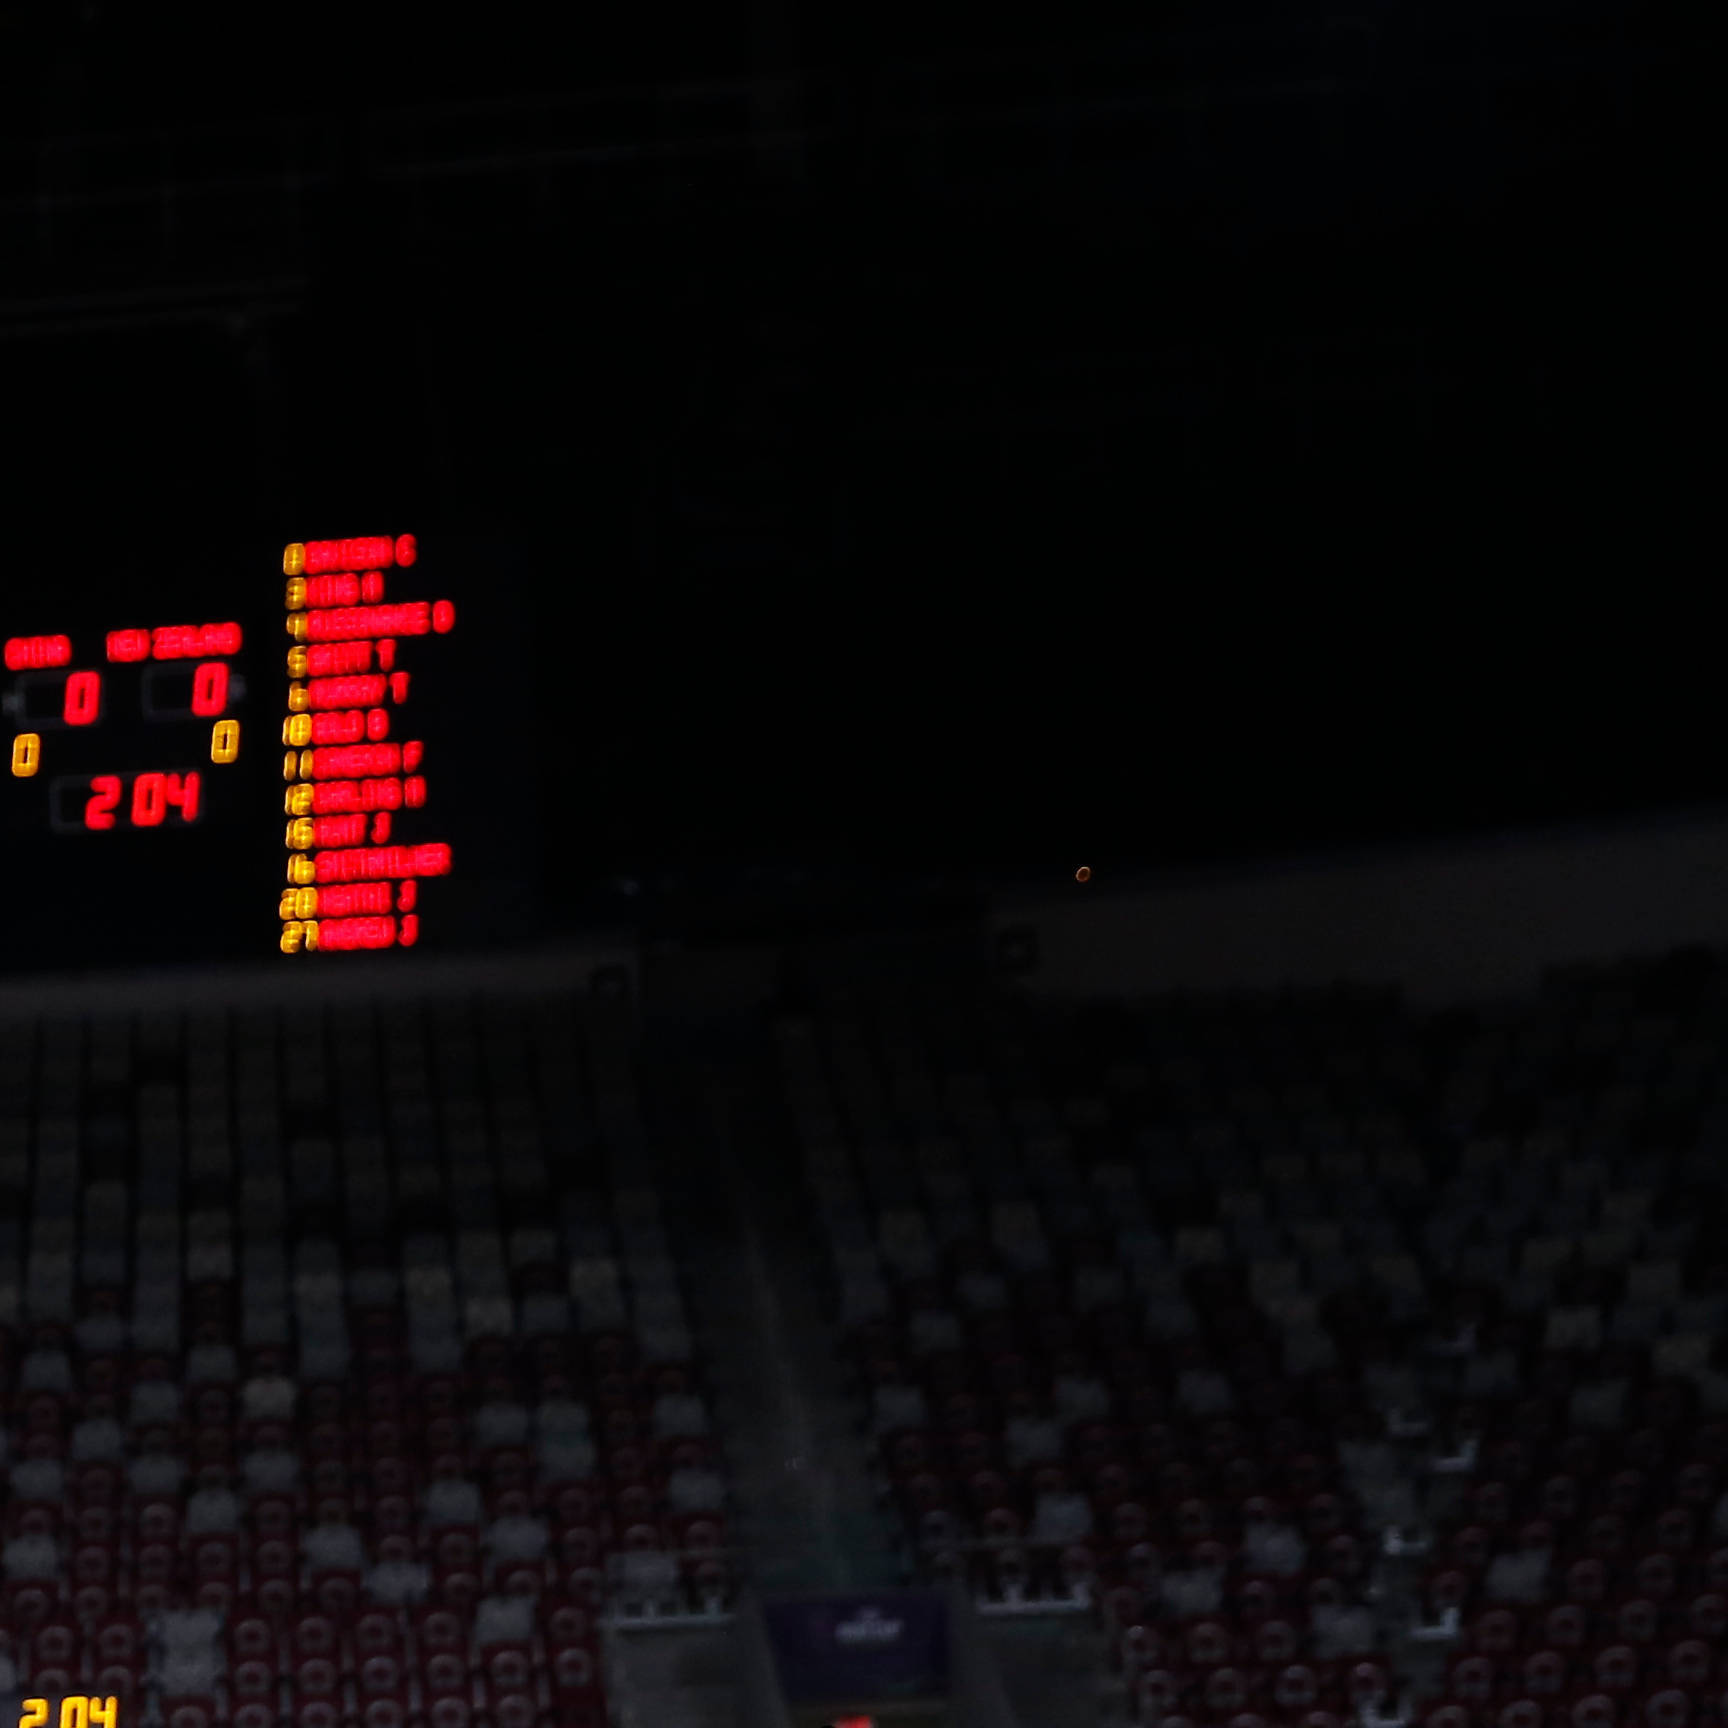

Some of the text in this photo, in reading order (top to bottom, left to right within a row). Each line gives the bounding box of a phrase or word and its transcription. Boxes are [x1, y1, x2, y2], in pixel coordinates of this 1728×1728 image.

[63, 670, 101, 726] 0
[190, 662, 229, 717] 0
[11, 733, 41, 778] 0
[211, 719, 240, 764] 0
